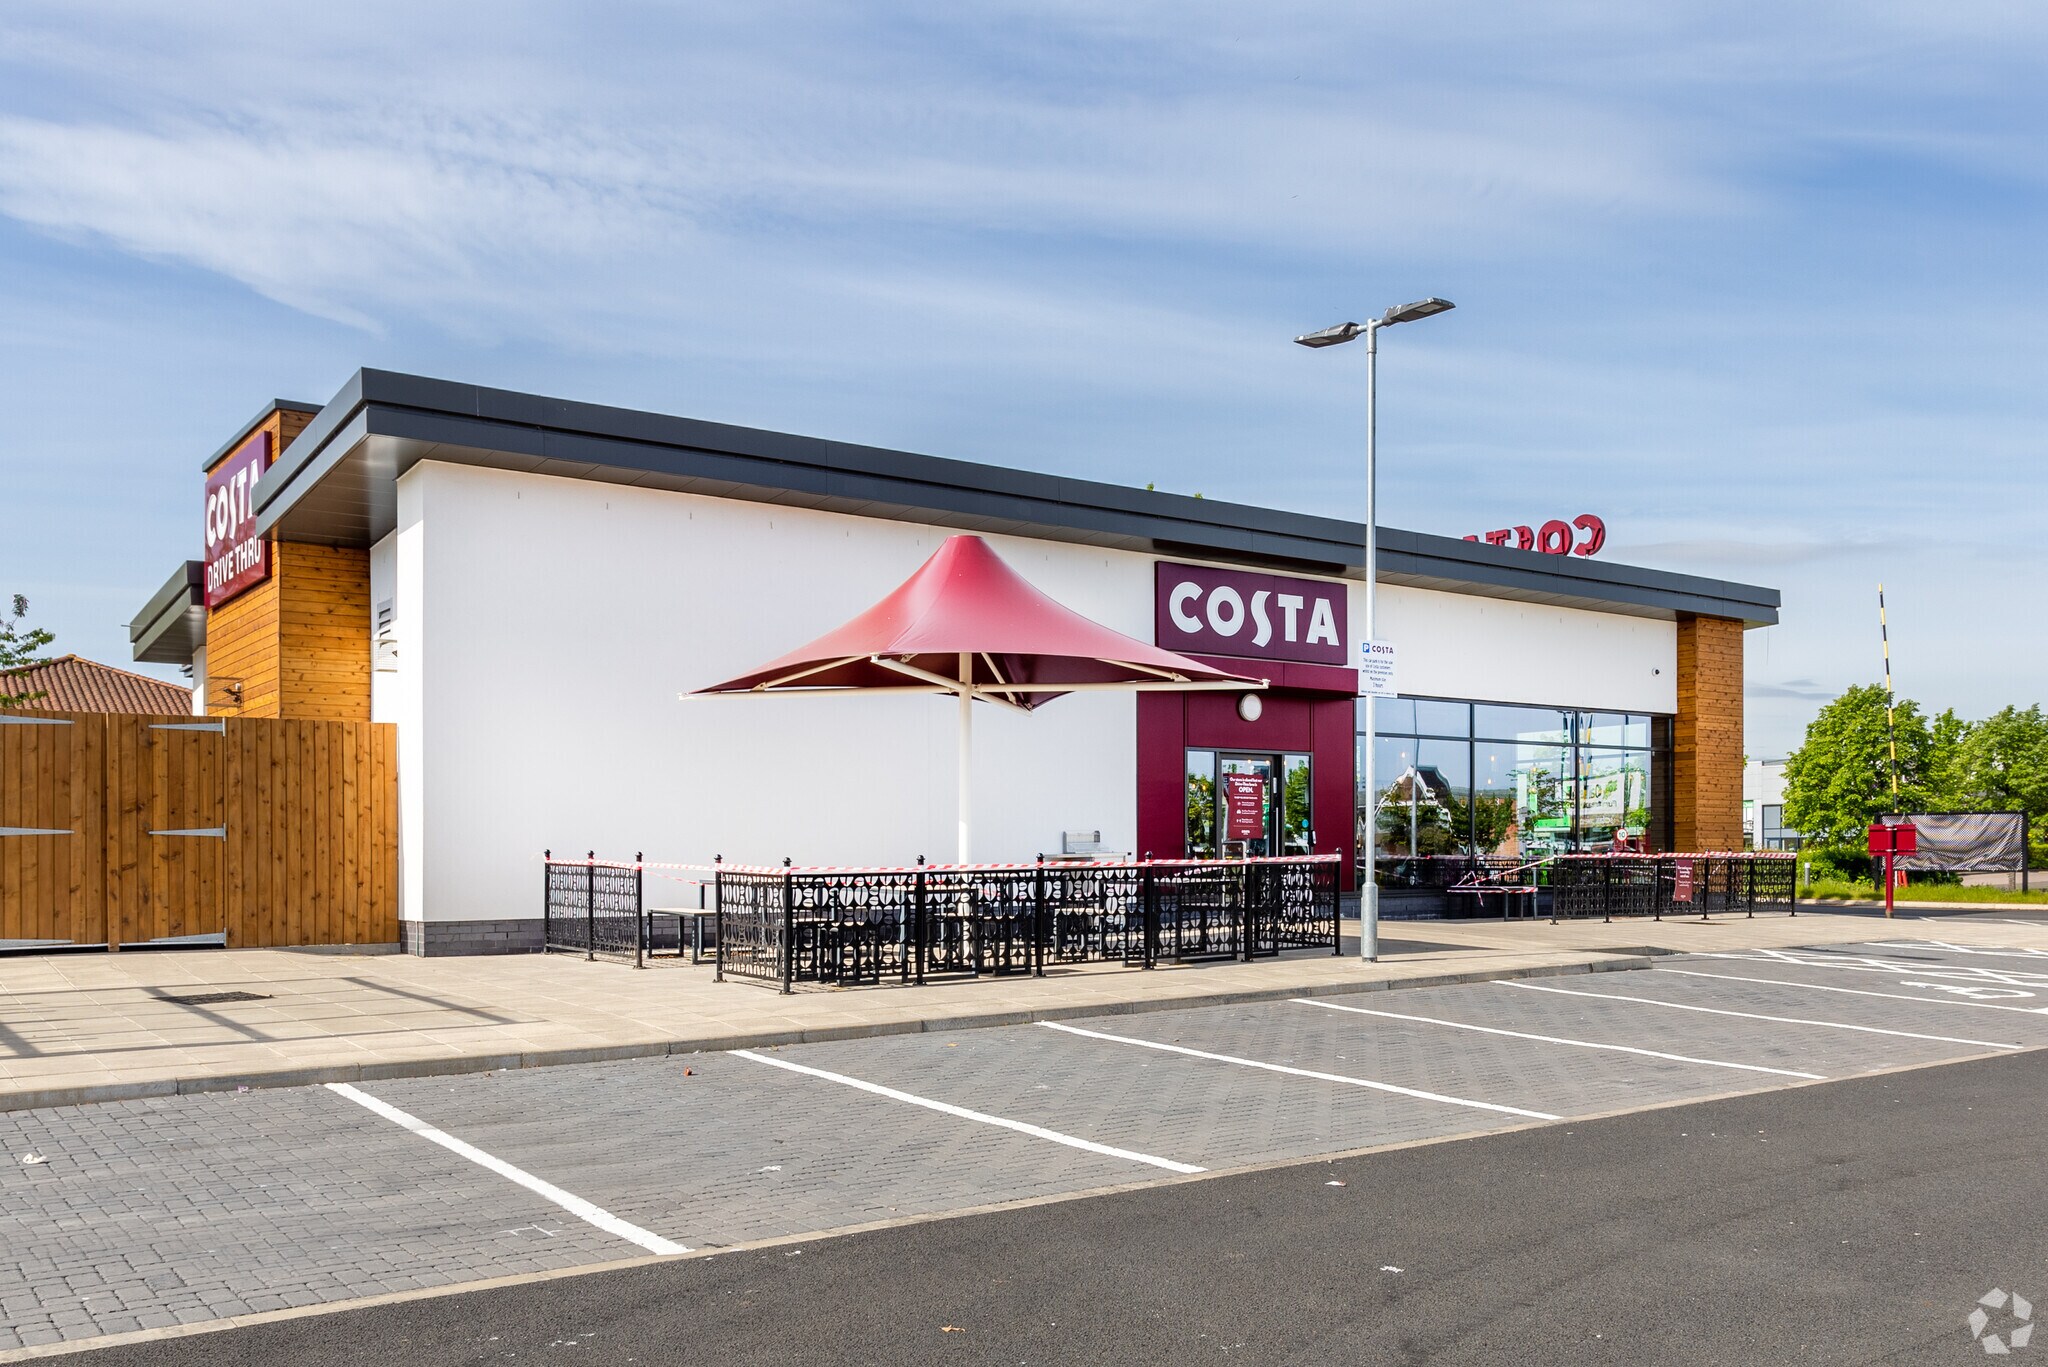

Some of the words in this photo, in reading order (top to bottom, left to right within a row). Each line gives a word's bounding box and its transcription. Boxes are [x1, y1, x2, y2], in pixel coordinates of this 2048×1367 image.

[206, 458, 259, 548] COSTA
[207, 550, 234, 593] DRIVE
[235, 535, 261, 575] THRU
[1169, 581, 1340, 648] COSTA
[1371, 645, 1394, 654] COSTA
